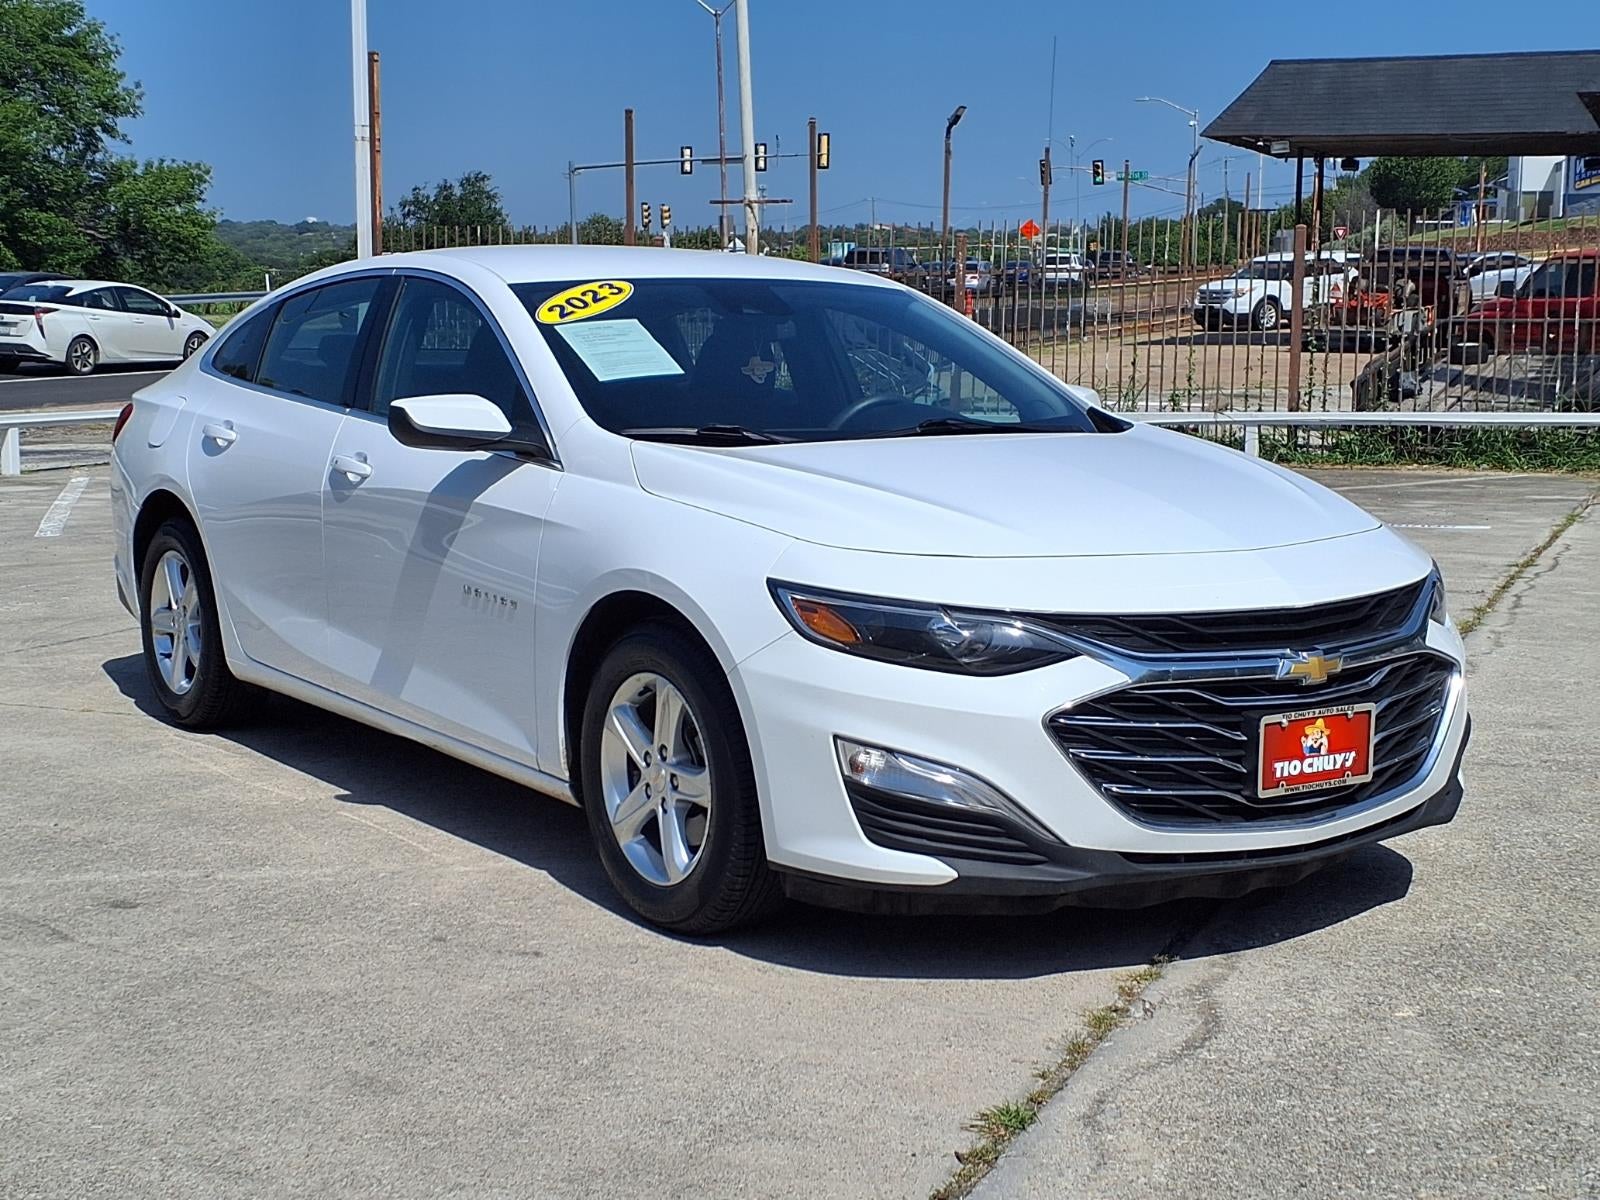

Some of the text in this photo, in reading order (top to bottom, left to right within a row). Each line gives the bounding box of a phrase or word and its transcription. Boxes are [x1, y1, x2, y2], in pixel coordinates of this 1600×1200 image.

[547, 282, 624, 319] 2023
[1293, 710, 1317, 719] CHUY'S
[1318, 707, 1335, 716] AUTO
[1336, 705, 1355, 713] SALES
[1273, 751, 1356, 778] TIO CHUY'S
